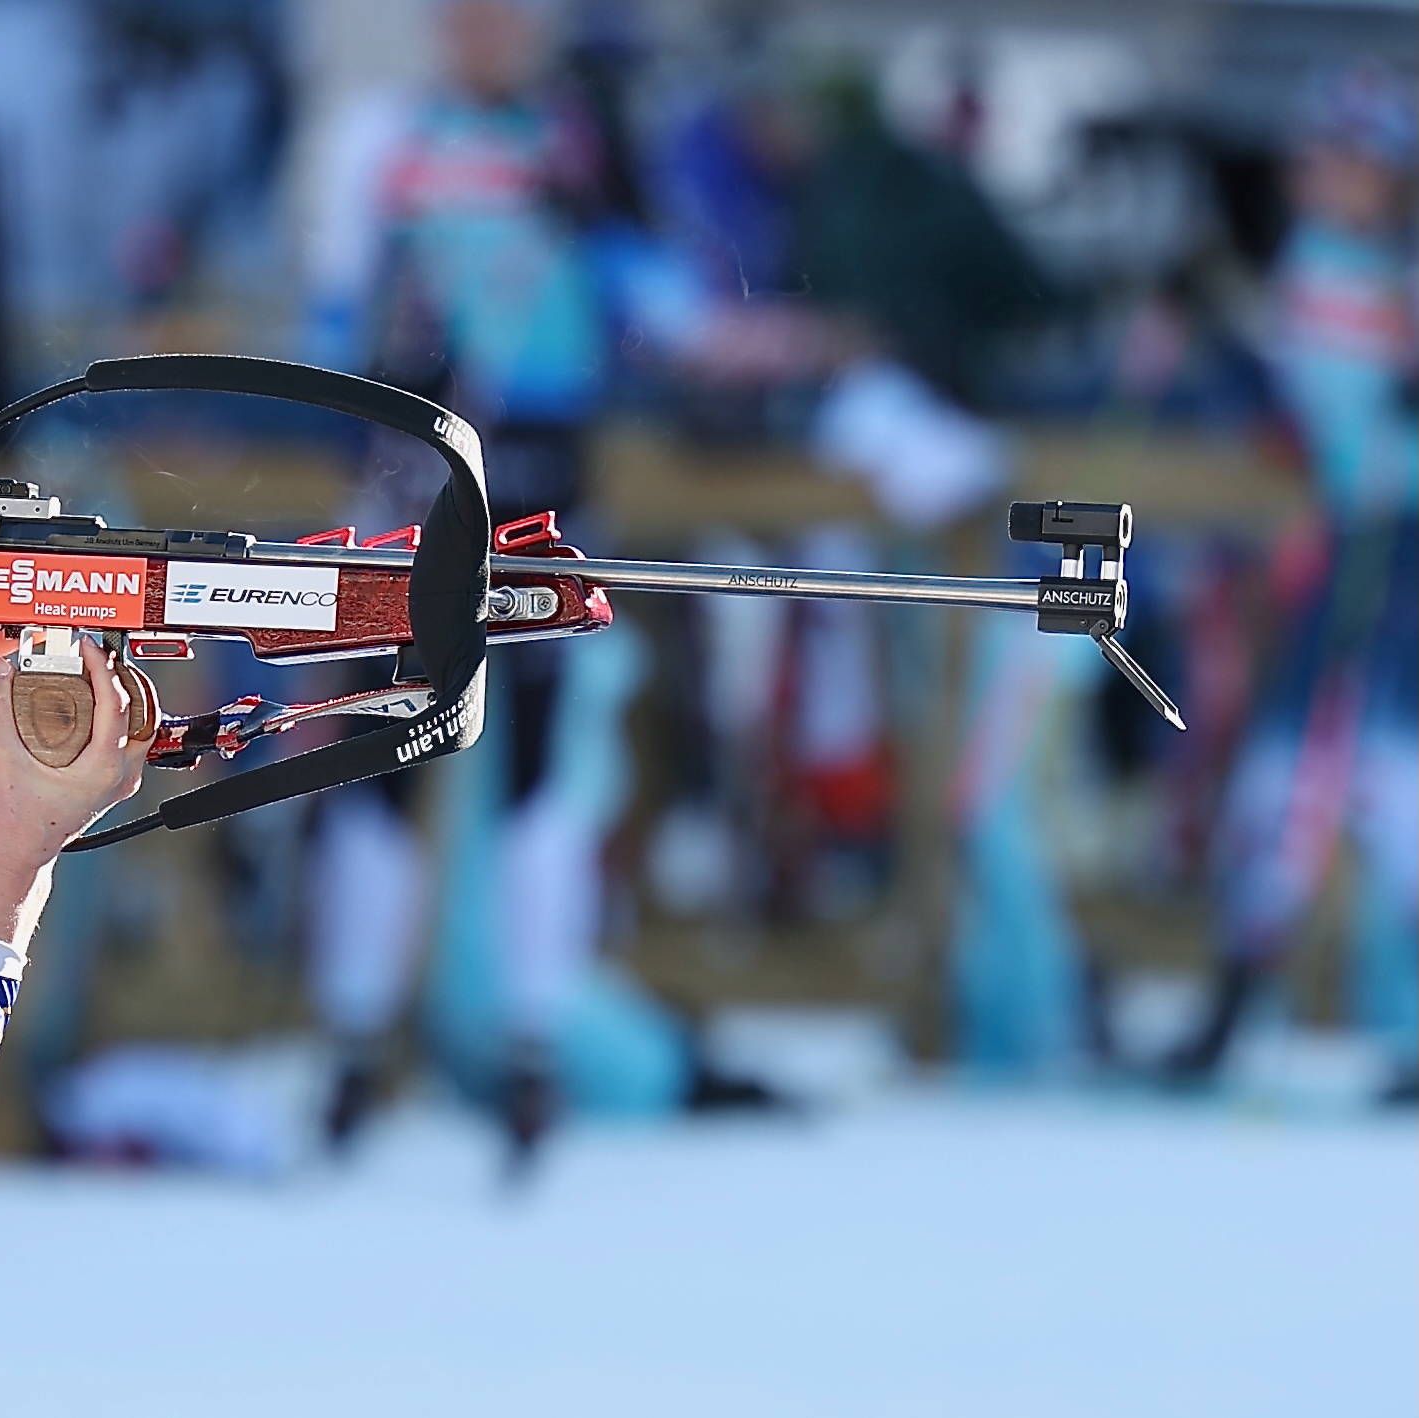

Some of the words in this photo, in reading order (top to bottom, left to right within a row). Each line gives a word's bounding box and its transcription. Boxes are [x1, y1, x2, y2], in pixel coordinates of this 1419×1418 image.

[209, 588, 338, 607] EURENCO
[34, 602, 67, 616] Heat
[70, 605, 117, 620] pumps
[395, 726, 445, 763] Lain
